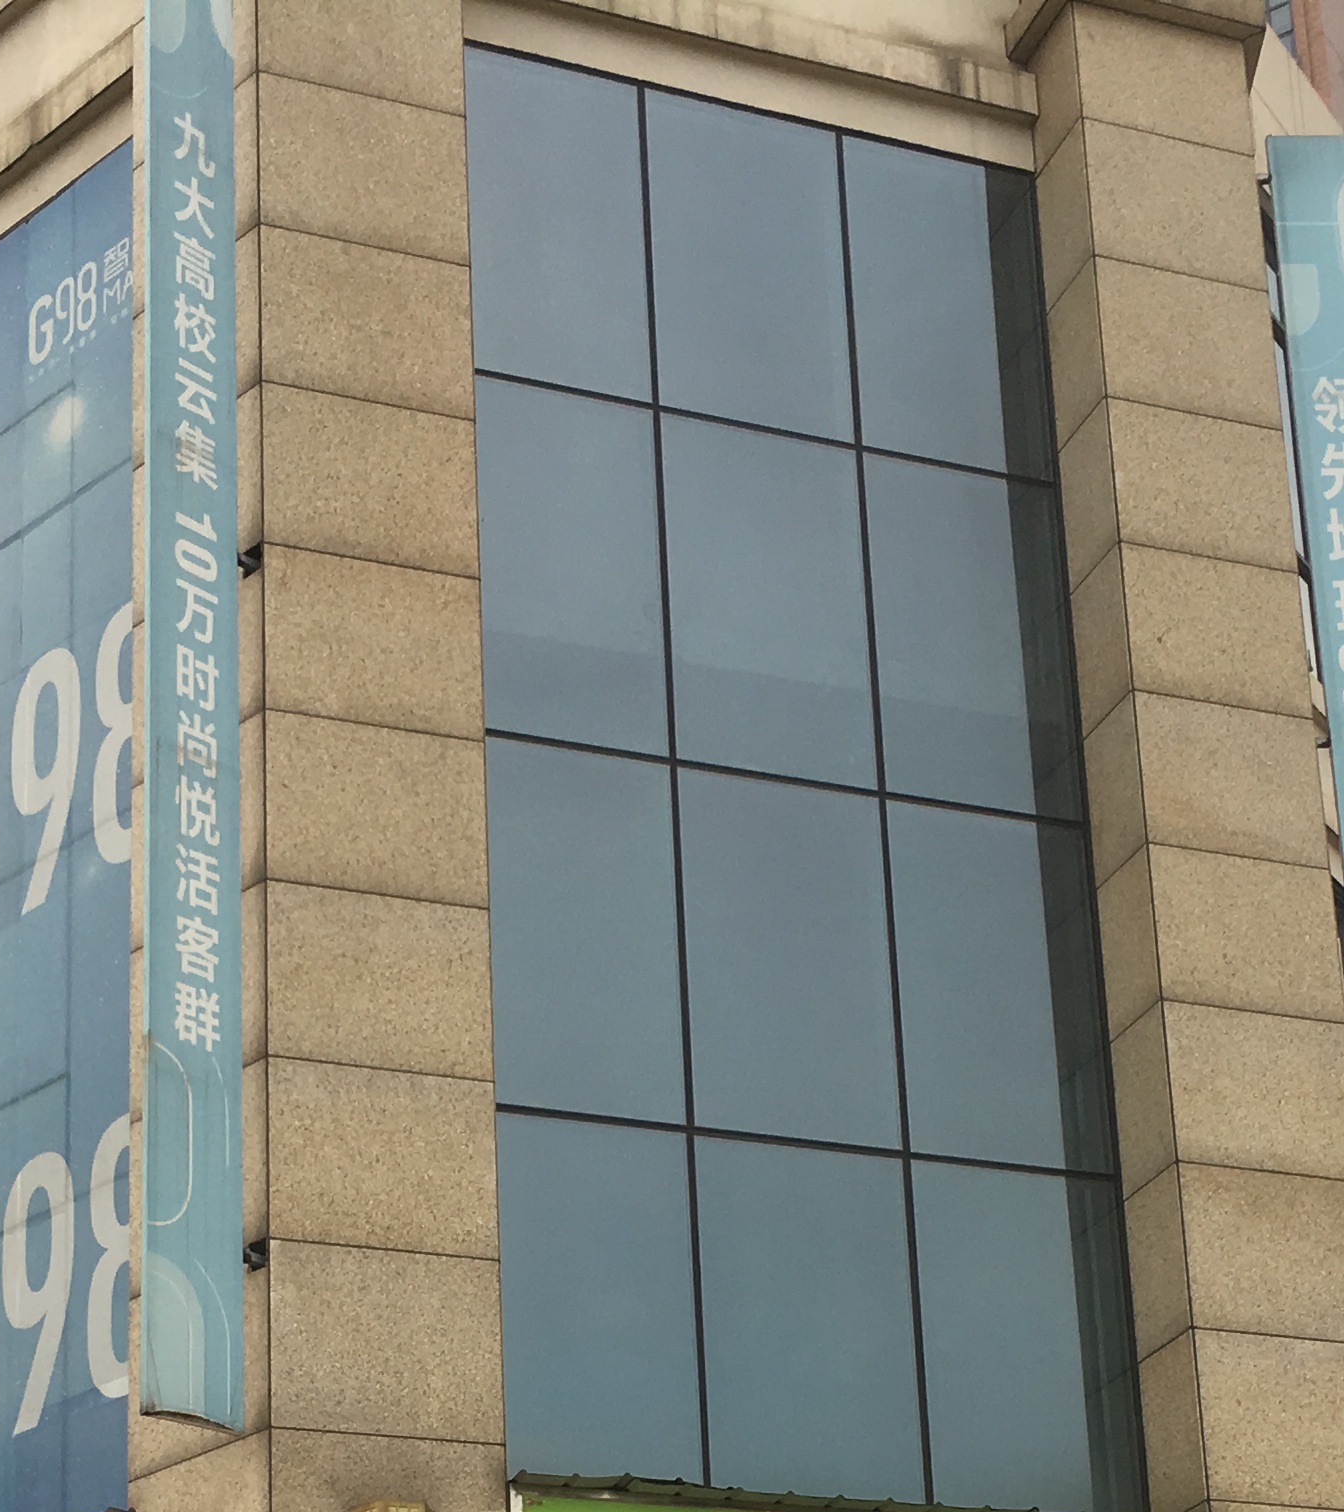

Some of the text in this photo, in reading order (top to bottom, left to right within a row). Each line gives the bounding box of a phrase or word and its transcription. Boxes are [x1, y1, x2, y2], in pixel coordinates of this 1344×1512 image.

[28, 261, 97, 365] G98
[173, 111, 221, 1054] 九大高校云集 10万时尚悦活客群
